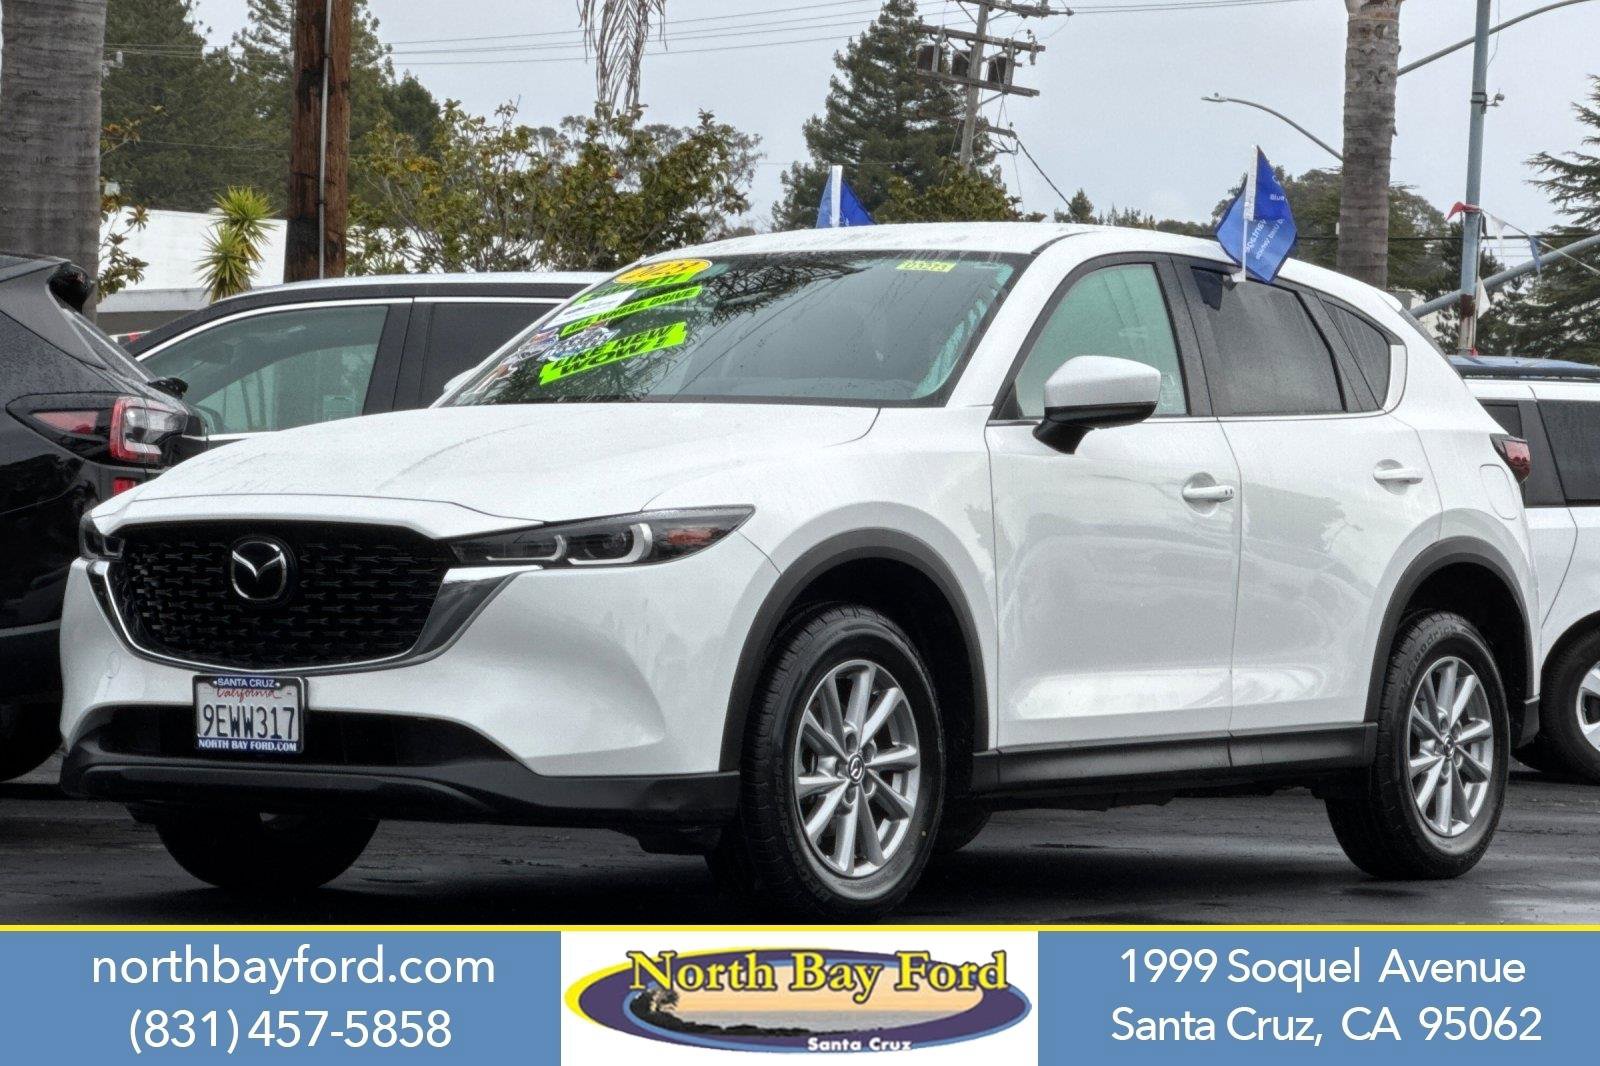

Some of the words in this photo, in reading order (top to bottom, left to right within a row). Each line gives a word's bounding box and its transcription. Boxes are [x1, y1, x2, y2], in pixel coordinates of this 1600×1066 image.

[599, 300, 648, 320] WHEEL
[648, 287, 699, 305] DRIVE
[551, 345, 603, 370] LIKE
[612, 324, 672, 348] NEW
[560, 342, 650, 375] WOW
[217, 677, 248, 688] SANTA
[249, 678, 275, 689] CRUZ
[203, 704, 295, 740] 9EWW317
[198, 739, 230, 750] NORTH
[231, 740, 248, 750] BAY
[249, 741, 297, 752] FORD.COM
